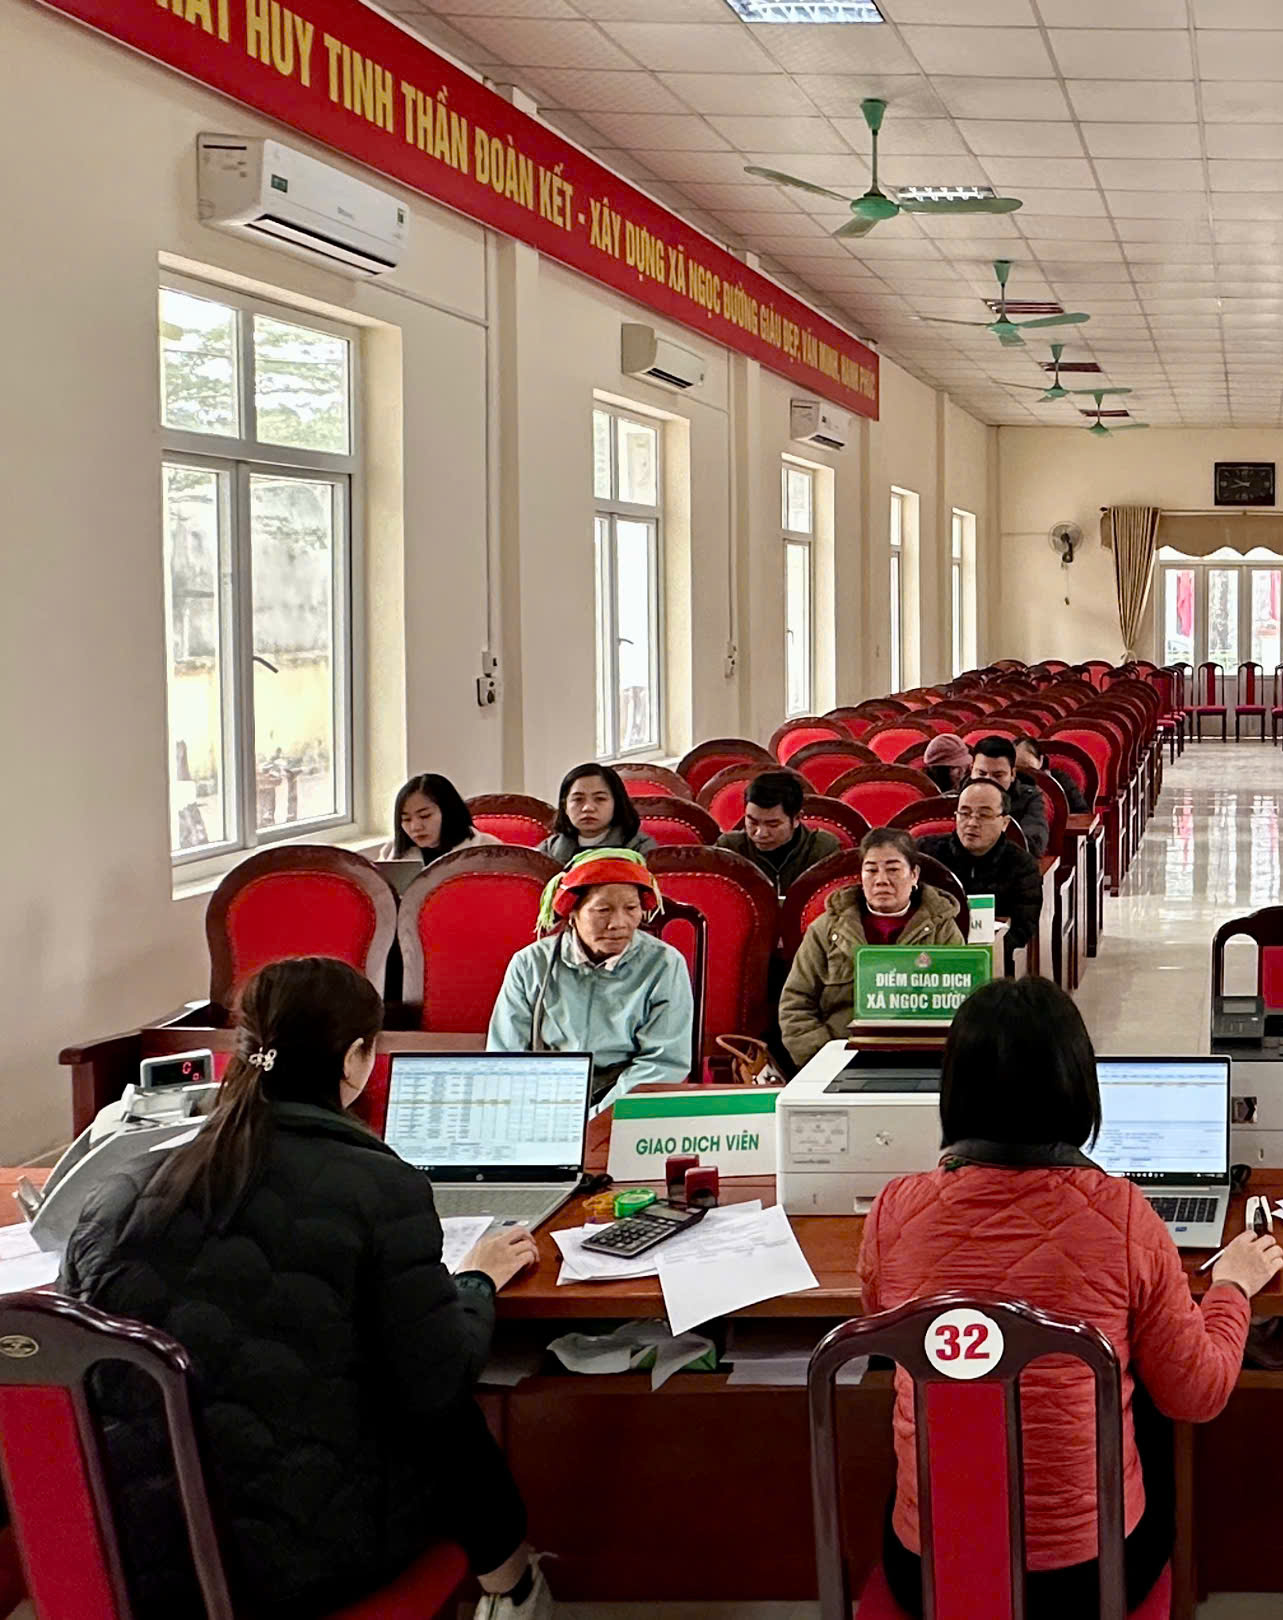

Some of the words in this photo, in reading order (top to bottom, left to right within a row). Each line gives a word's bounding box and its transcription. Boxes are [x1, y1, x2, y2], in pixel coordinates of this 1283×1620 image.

[246, 0, 315, 88] HUY
[323, 33, 395, 134] TINH
[401, 80, 468, 175] THẦN
[475, 125, 534, 212] ĐOÀN
[539, 162, 573, 232] KẾT
[589, 196, 622, 259] XÂY
[625, 219, 665, 284] DỰNG
[668, 244, 687, 296] XÃ
[688, 258, 721, 319] NGỌC
[876, 968, 907, 988] ĐIỂM
[911, 973, 939, 988] GIAO
[942, 973, 972, 990] DỊCH
[867, 990, 886, 1009] XÃ
[889, 993, 928, 1012] NGỌC
[636, 1137, 677, 1155] GIAO
[726, 1129, 760, 1151] VIÊN
[935, 1323, 990, 1361] 32
